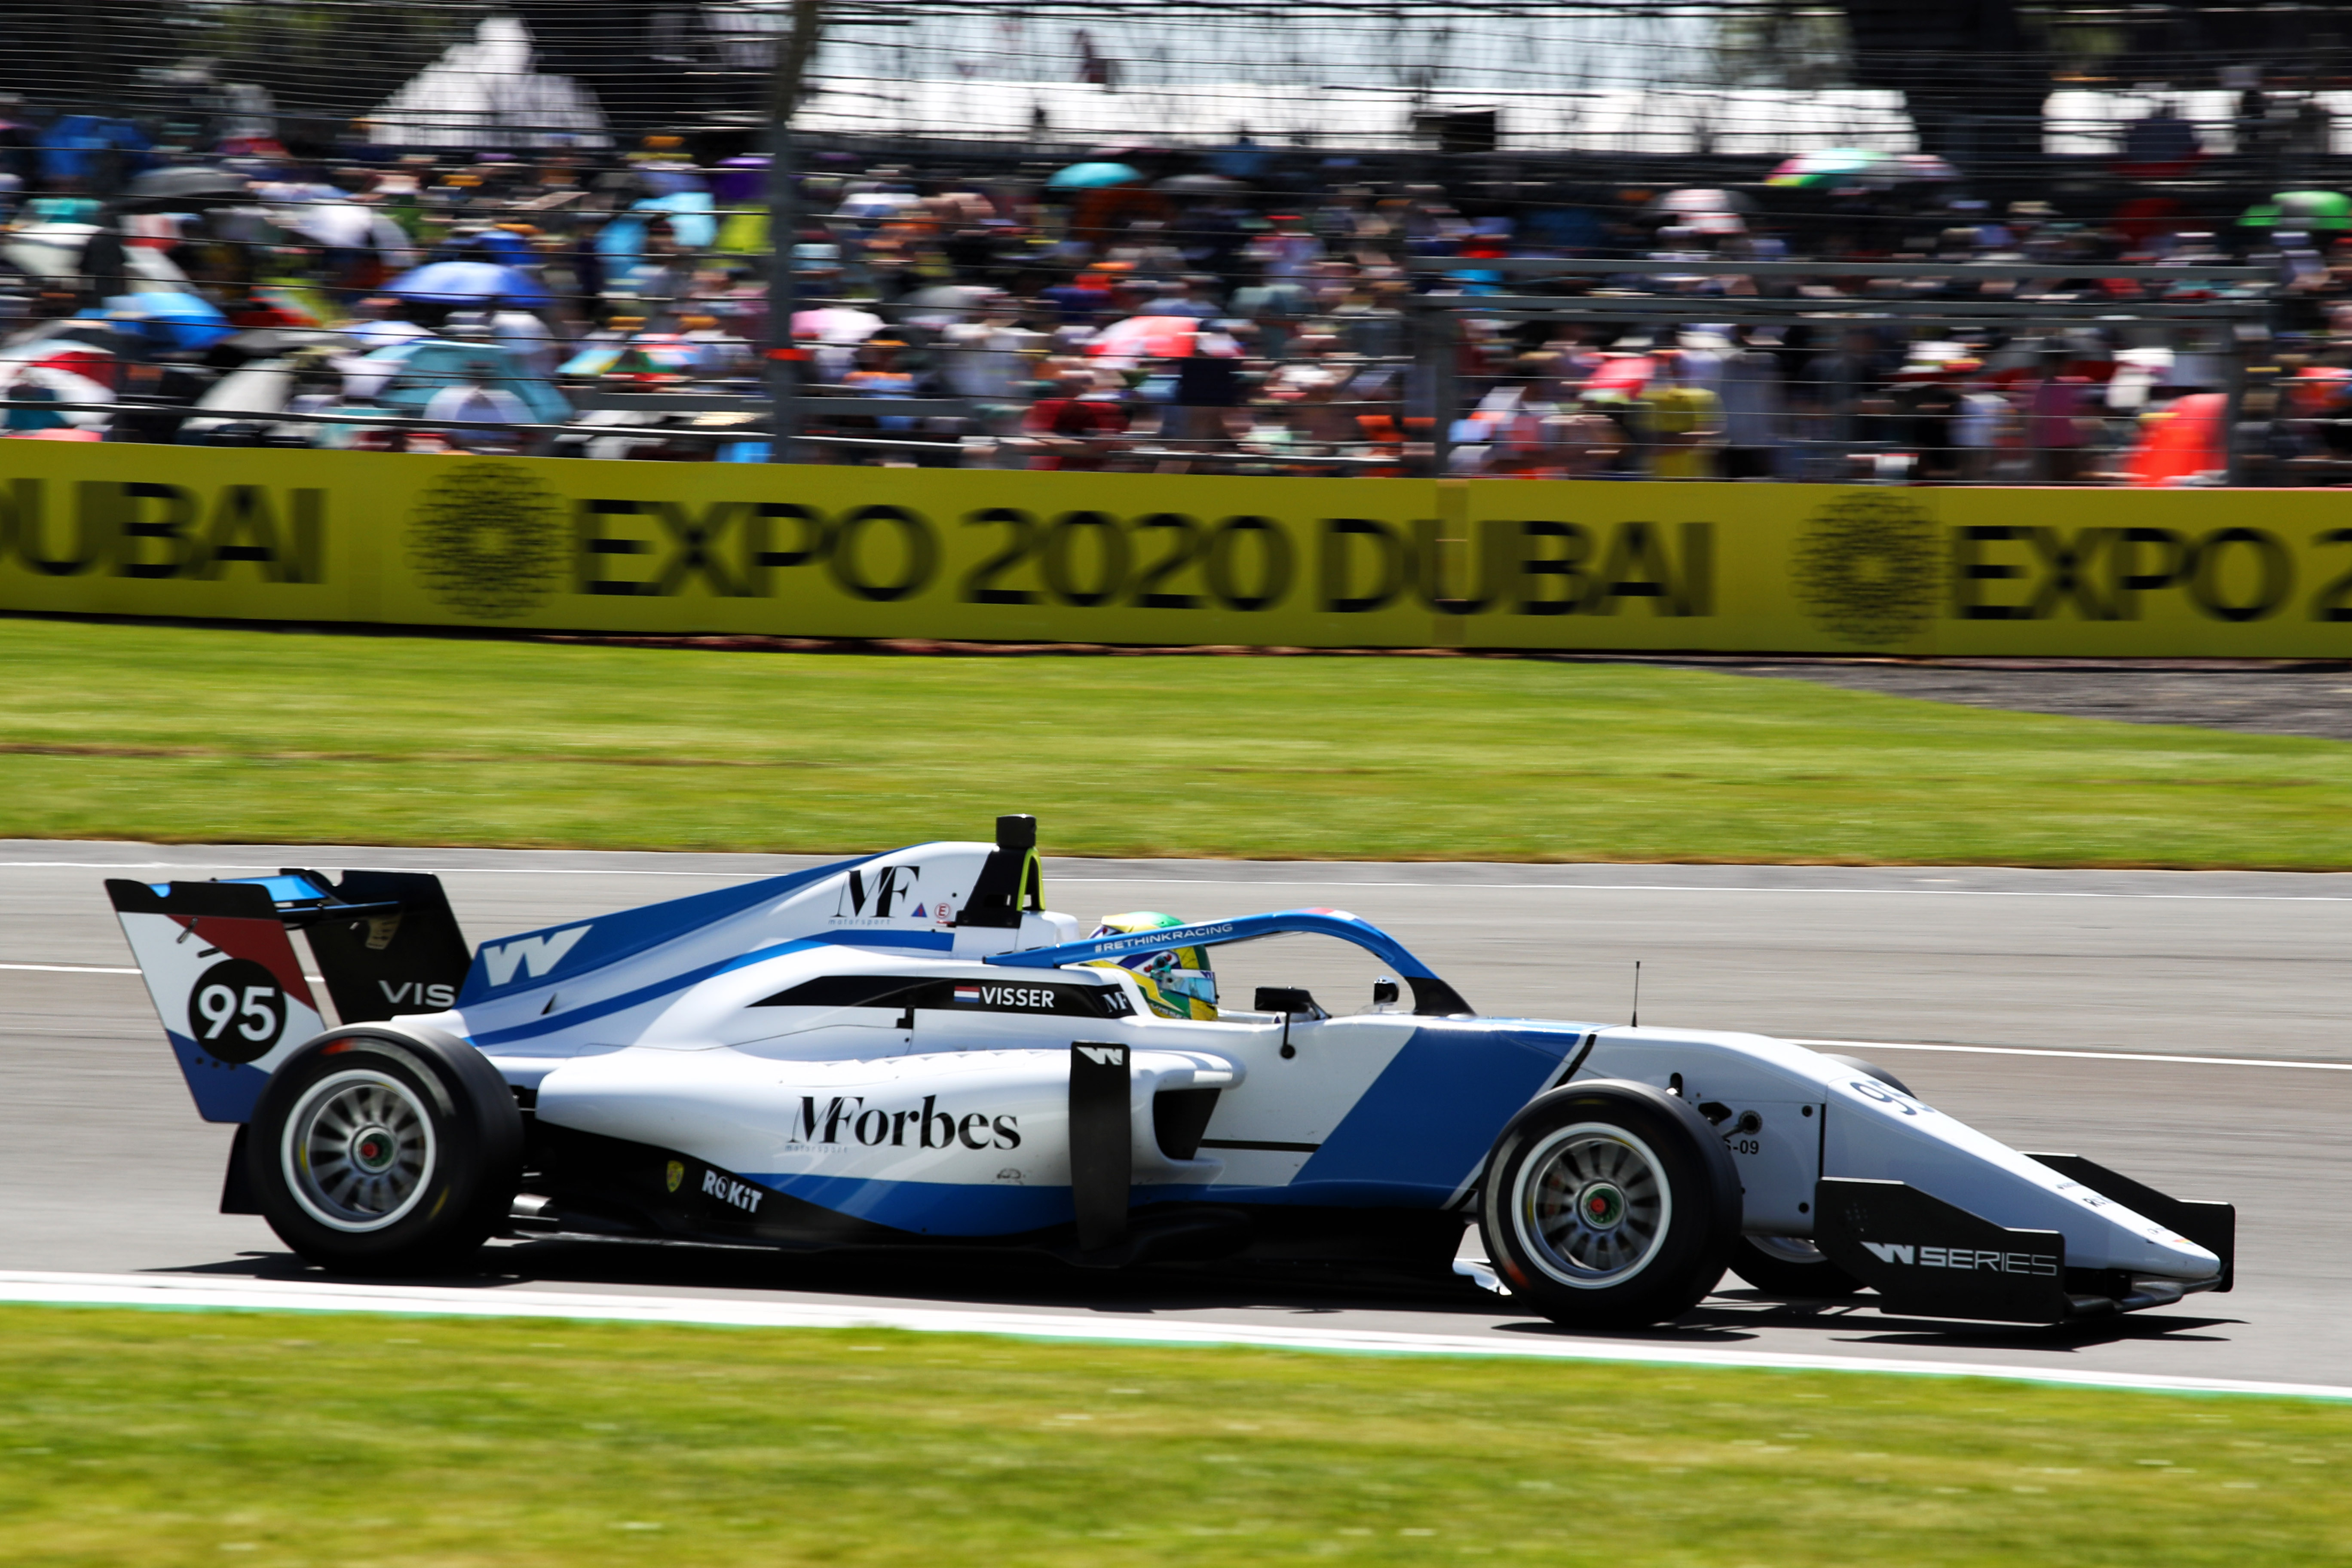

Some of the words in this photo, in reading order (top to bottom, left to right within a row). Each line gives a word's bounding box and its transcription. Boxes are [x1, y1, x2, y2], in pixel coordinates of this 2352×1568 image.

[0, 478, 329, 584] UBAI
[574, 498, 943, 602] EXPO
[959, 508, 1299, 613] 2020
[1314, 518, 1716, 617] DUBAI
[1949, 525, 2301, 622] EXPO
[835, 865, 920, 918] MF
[828, 918, 891, 926] motorsport
[482, 924, 594, 987] W
[198, 983, 277, 1041] 95
[981, 986, 1055, 1008] VISSER
[1076, 1046, 1123, 1065] W
[1859, 1240, 1914, 1265] W
[1919, 1246, 2058, 1276] SERIES
